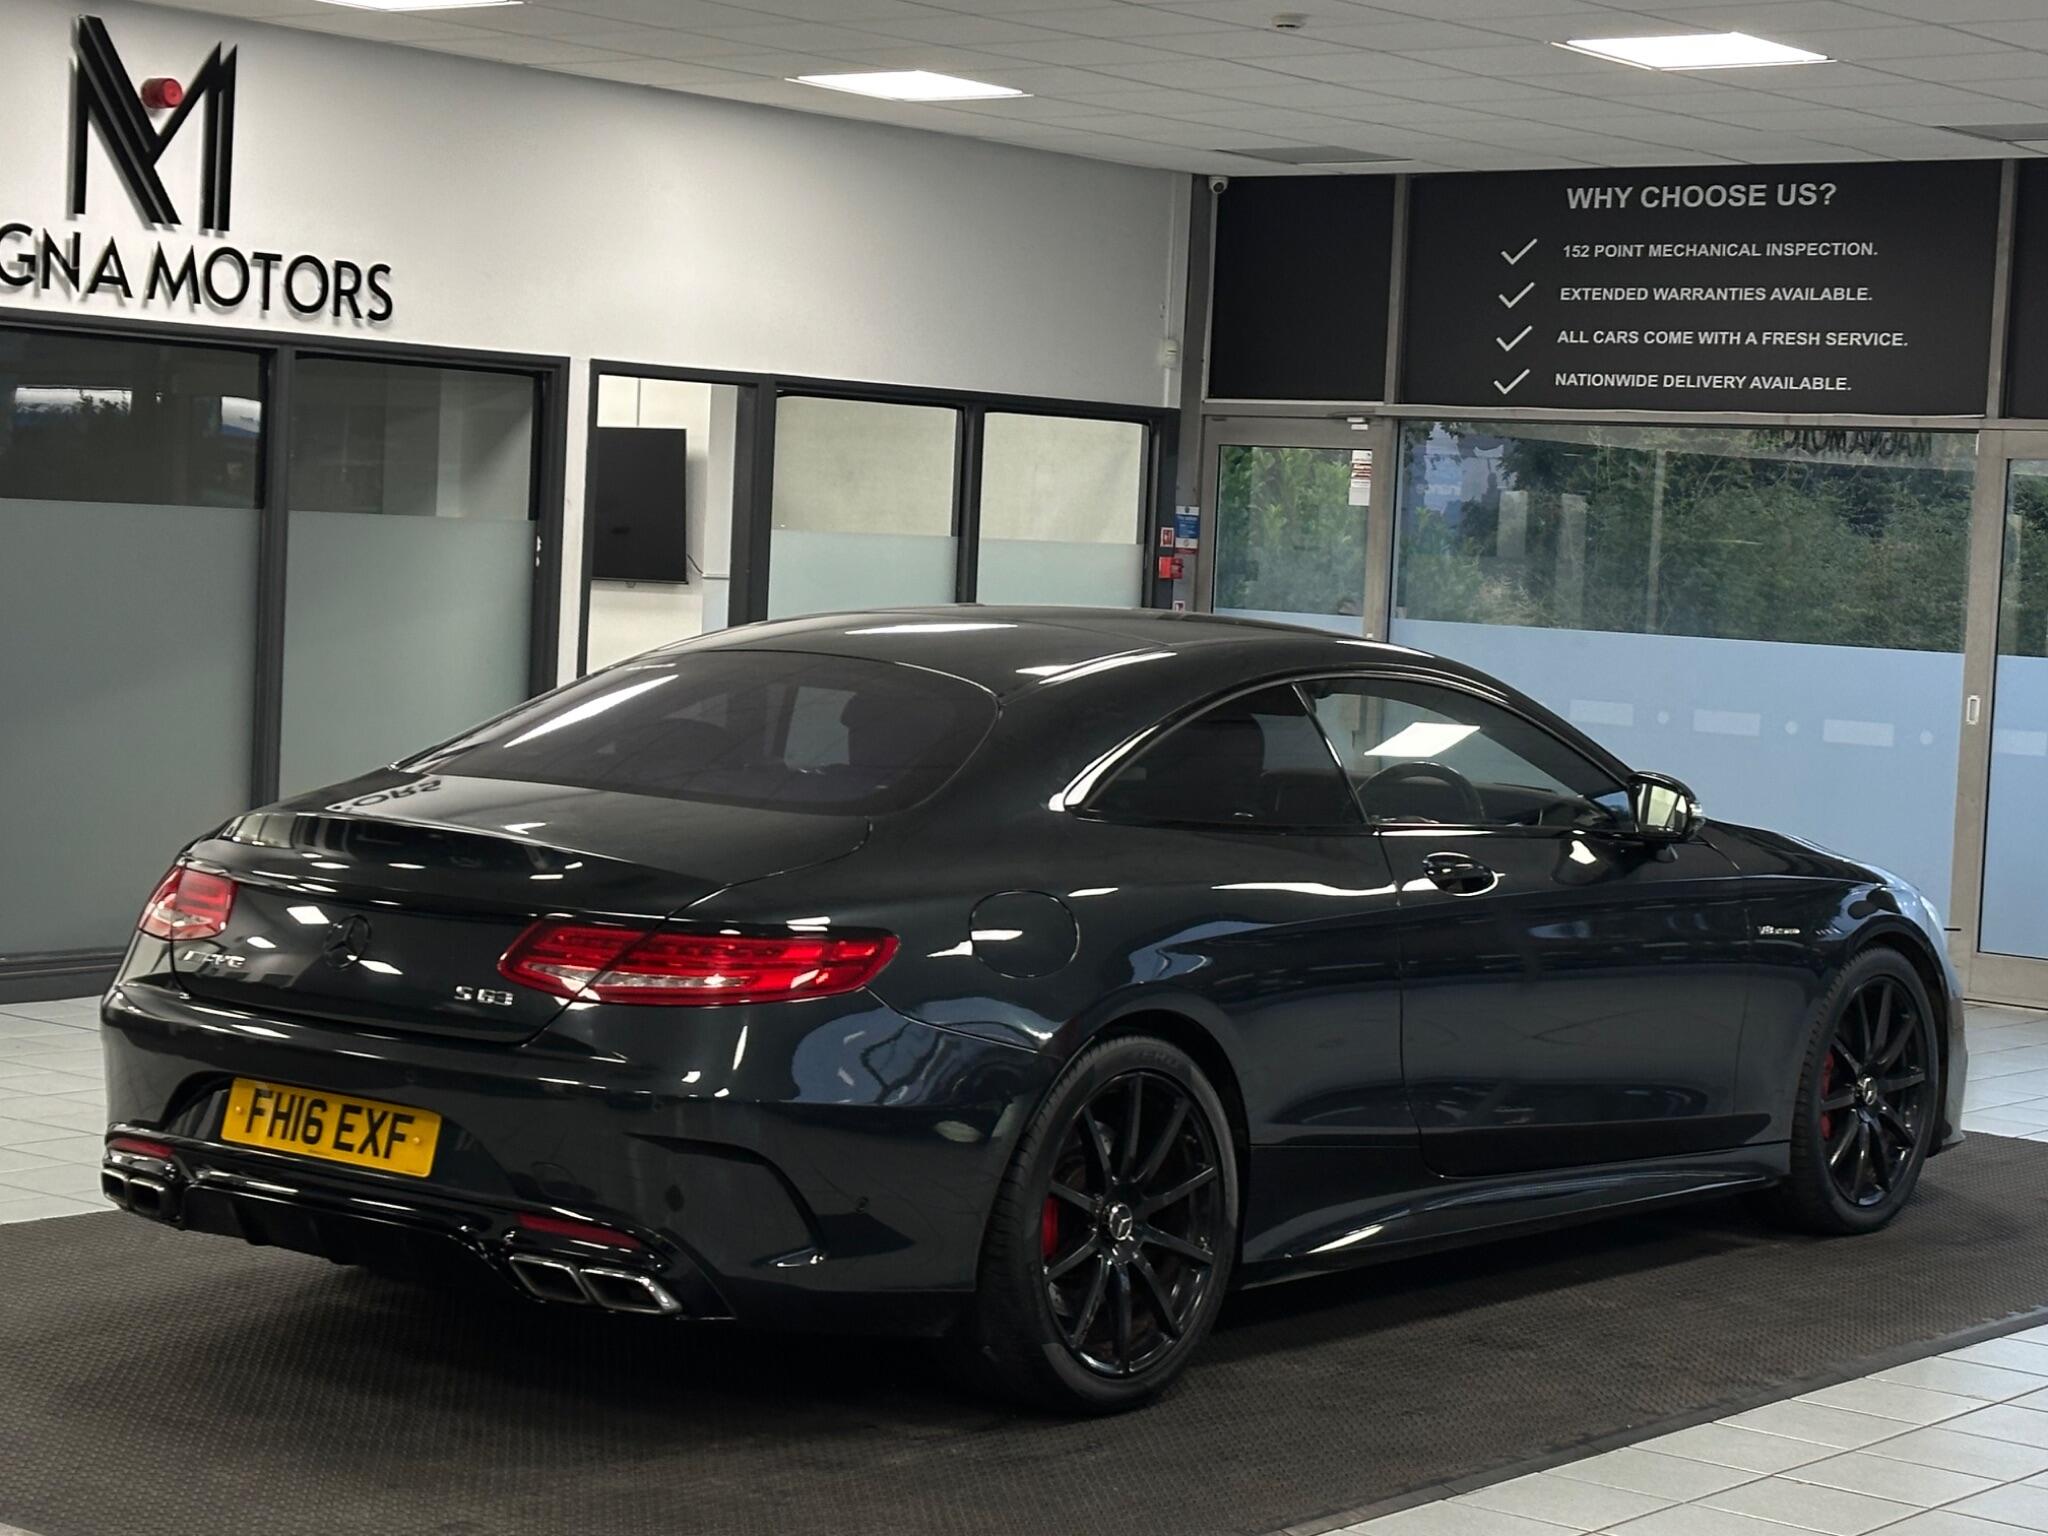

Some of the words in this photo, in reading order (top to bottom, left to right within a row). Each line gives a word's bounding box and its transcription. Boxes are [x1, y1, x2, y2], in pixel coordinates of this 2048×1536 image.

[1567, 187, 1633, 209] WHY
[1641, 185, 1767, 208] CHOOSE
[1777, 183, 1837, 206] US?
[1563, 245, 1590, 257] 152
[1594, 245, 1644, 257] POINT
[1649, 244, 1762, 257] MECHANICAL
[1766, 243, 1878, 256] INSPECTION.
[0, 223, 134, 299] GNA
[147, 241, 393, 321] MOTORS
[1560, 288, 1648, 300] EXTENDED
[1653, 288, 1766, 300] WARRANTIES
[1770, 288, 1872, 300] AVAILABLE.
[1557, 331, 1589, 343] ALL
[1593, 331, 1639, 344] CARS
[1644, 331, 1694, 345] COME
[1698, 332, 1741, 345] WITH
[1745, 332, 1758, 345] A
[1762, 332, 1820, 345] FRESH
[1825, 332, 1908, 346] SERVICE.
[1555, 373, 1658, 387] NATIONWIDE
[1663, 375, 1746, 388] DELIVERY
[1750, 376, 1852, 391] AVAILABLE.
[454, 985, 473, 1001] S
[477, 988, 514, 1006] 63
[245, 1087, 329, 1146] FH16
[332, 1103, 415, 1160] EXF
